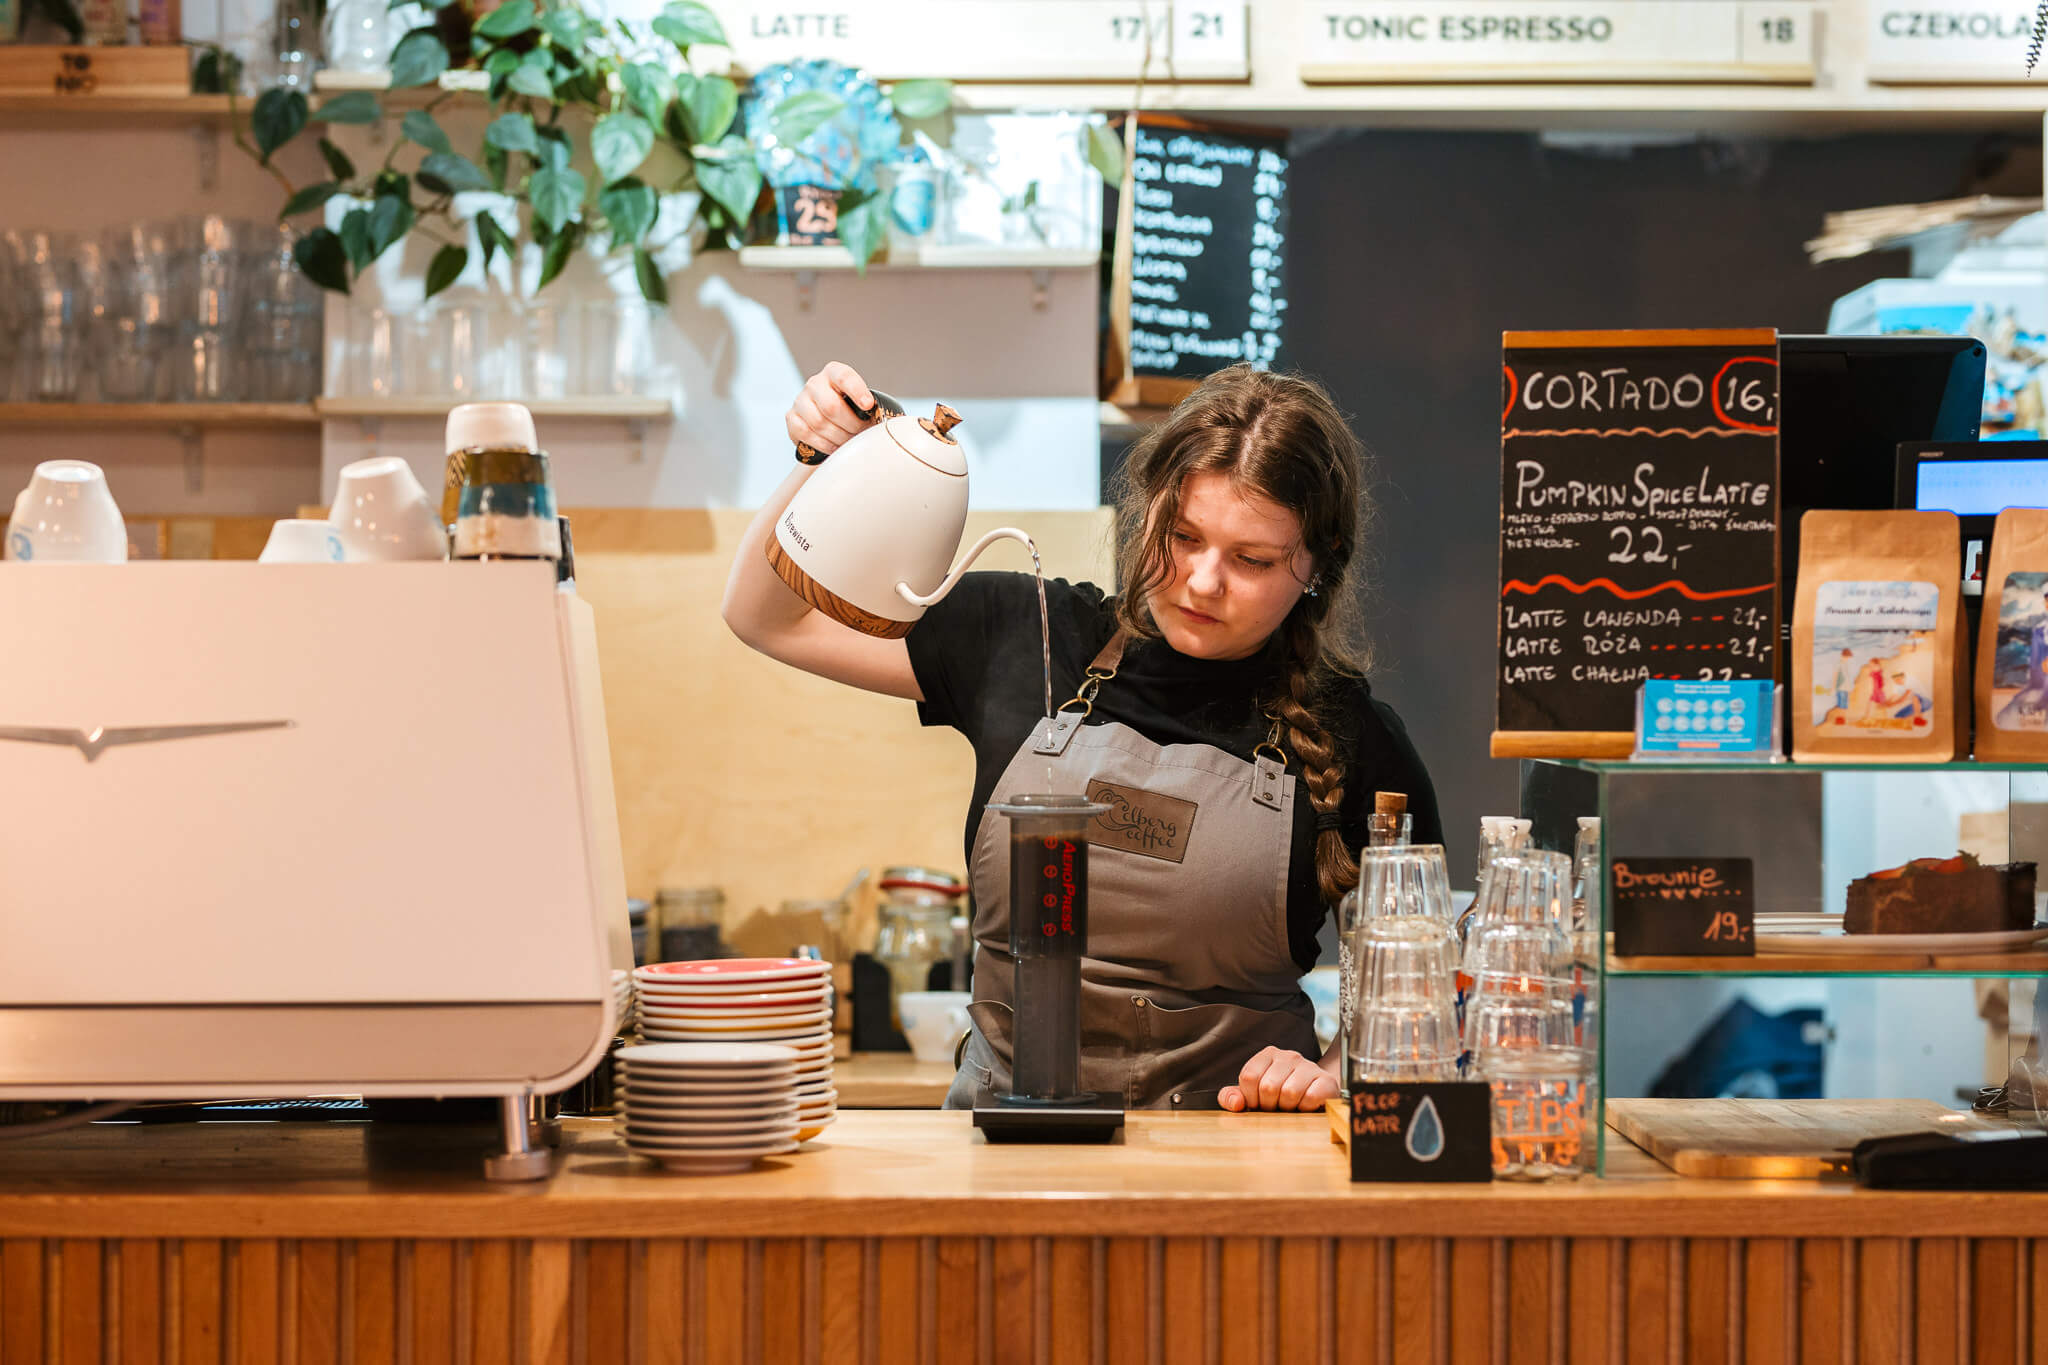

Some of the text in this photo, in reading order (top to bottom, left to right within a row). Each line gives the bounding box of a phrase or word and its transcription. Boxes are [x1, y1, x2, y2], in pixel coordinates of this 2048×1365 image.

[751, 14, 849, 38] LATTE
[1190, 12, 1222, 38] 21
[1325, 15, 1795, 42] TONIC ESPRESSO 18
[1523, 368, 1703, 411] CORTADO
[1516, 460, 1627, 508] PUMPKIN
[1608, 526, 1693, 570] 22,-
[1505, 606, 1567, 628] LATTE
[1583, 609, 1682, 628] LAWENDA
[1505, 637, 1562, 658] LATTE
[1504, 666, 1557, 684] LATTE
[1613, 862, 1725, 888] Brownie
